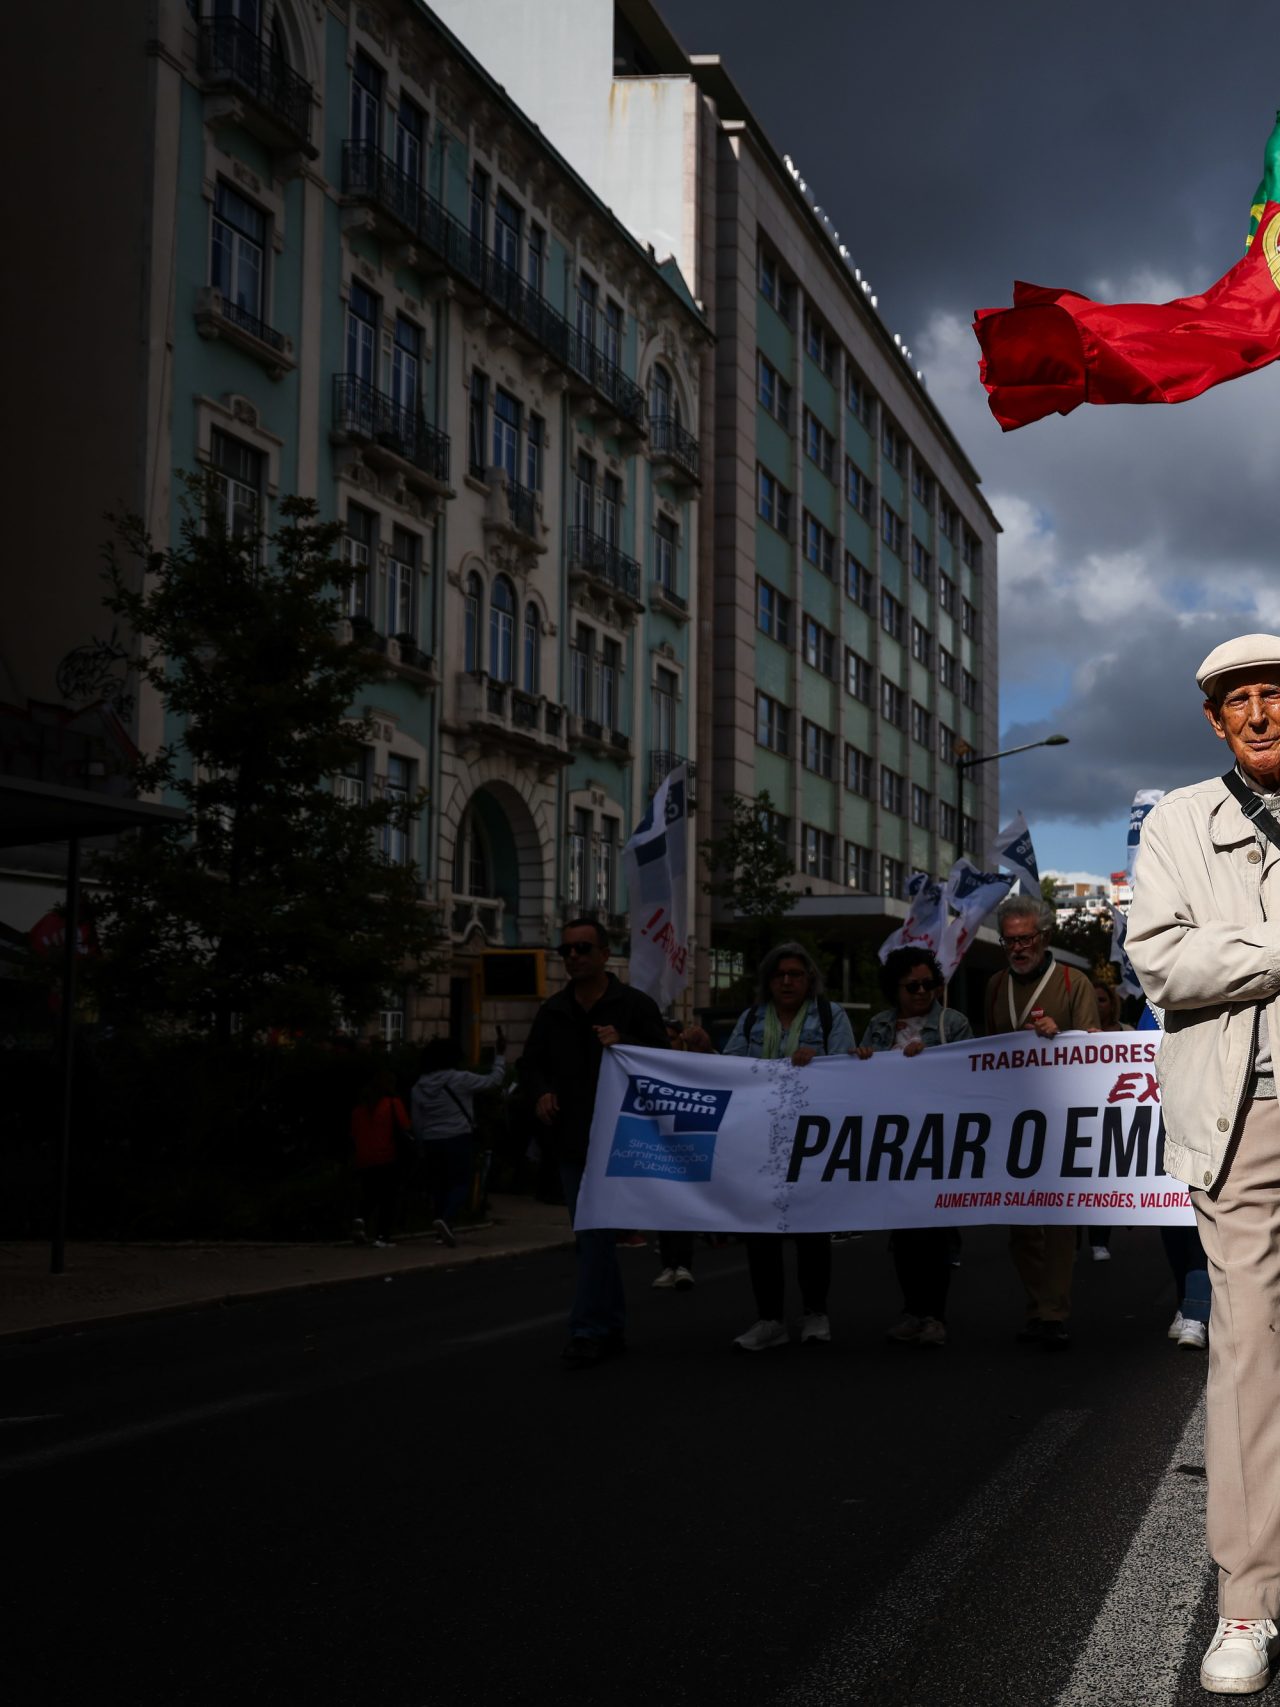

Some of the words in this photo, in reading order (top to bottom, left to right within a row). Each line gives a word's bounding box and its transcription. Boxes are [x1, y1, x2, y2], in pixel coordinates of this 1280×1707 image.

[968, 1043, 1155, 1072] TRABALHADORES
[636, 1079, 717, 1103] Frente
[633, 1096, 717, 1115] Comum
[628, 1139, 695, 1151] Sindicatos
[786, 1112, 991, 1182] PARAR
[1006, 1109, 1047, 1179] O
[612, 1150, 708, 1164] Administração
[633, 1160, 687, 1174] Pública
[934, 1192, 1001, 1208] AUMENTAR
[1004, 1189, 1064, 1207] SALÁRIOS
[1067, 1193, 1075, 1206] E
[1078, 1190, 1136, 1209] PENSÕES,
[1140, 1192, 1193, 1207] VALORIZ
